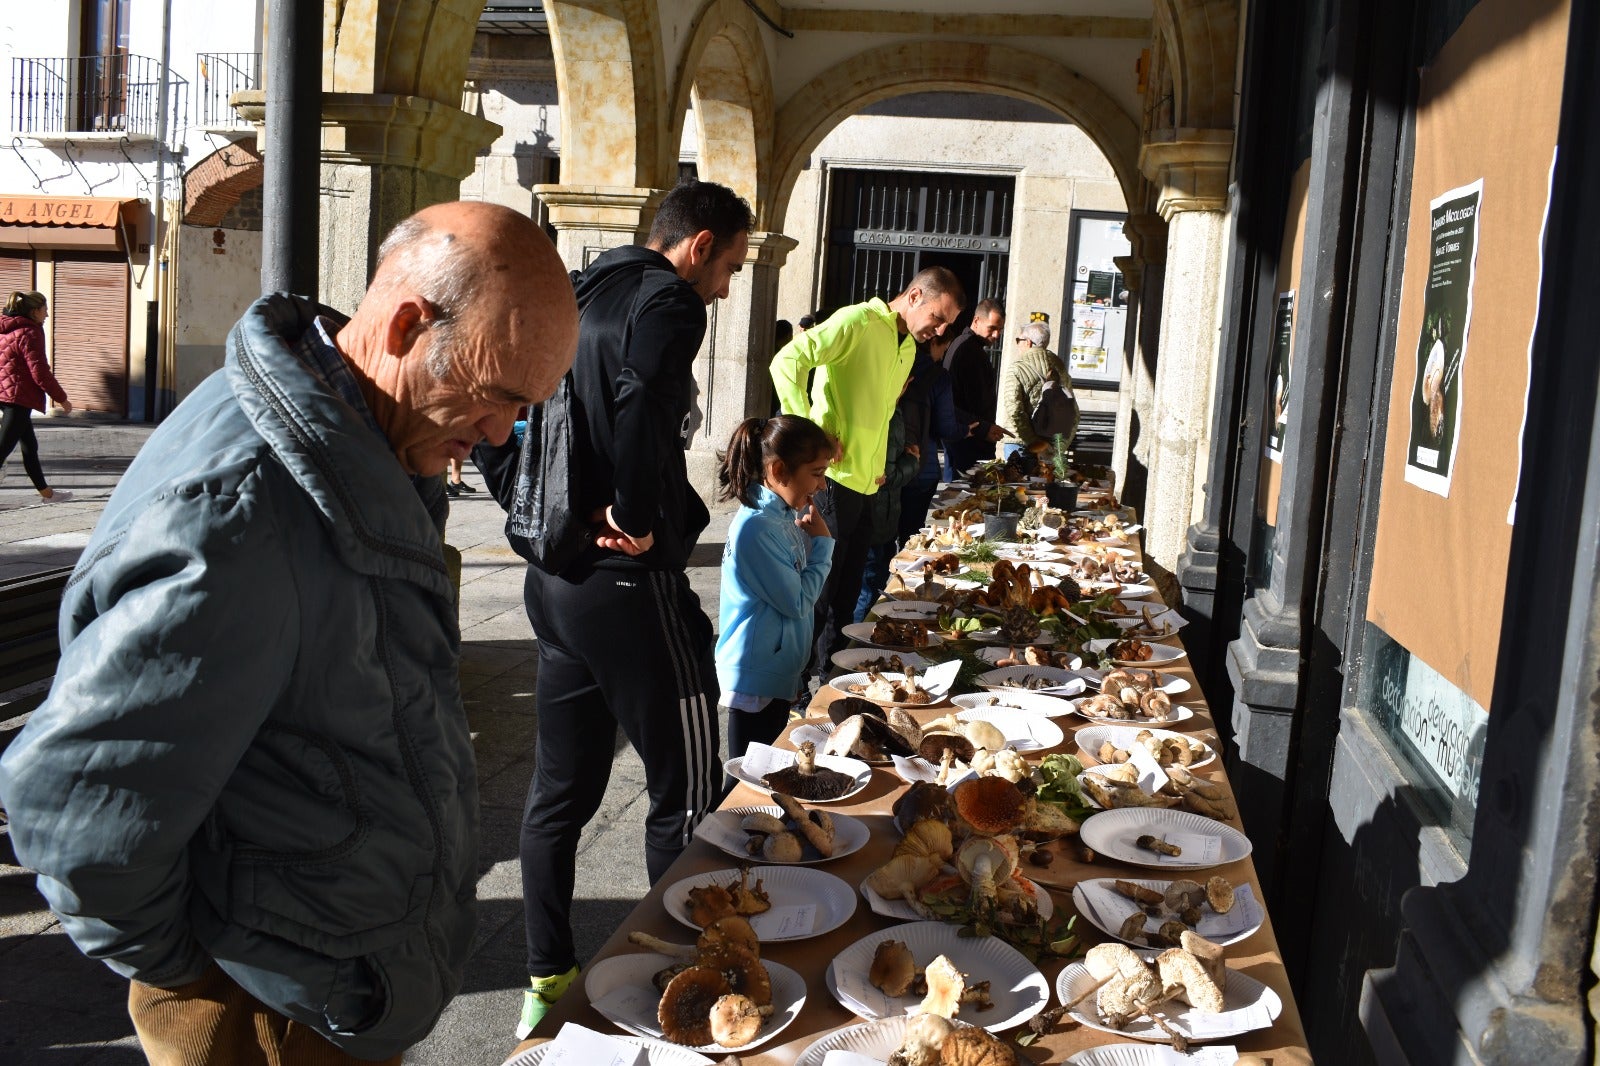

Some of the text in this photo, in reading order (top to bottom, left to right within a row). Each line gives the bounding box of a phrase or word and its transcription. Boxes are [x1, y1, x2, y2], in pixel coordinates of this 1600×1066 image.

[0, 201, 94, 219] A ANGEL
[859, 232, 982, 249] CASA DE CONCEJO
